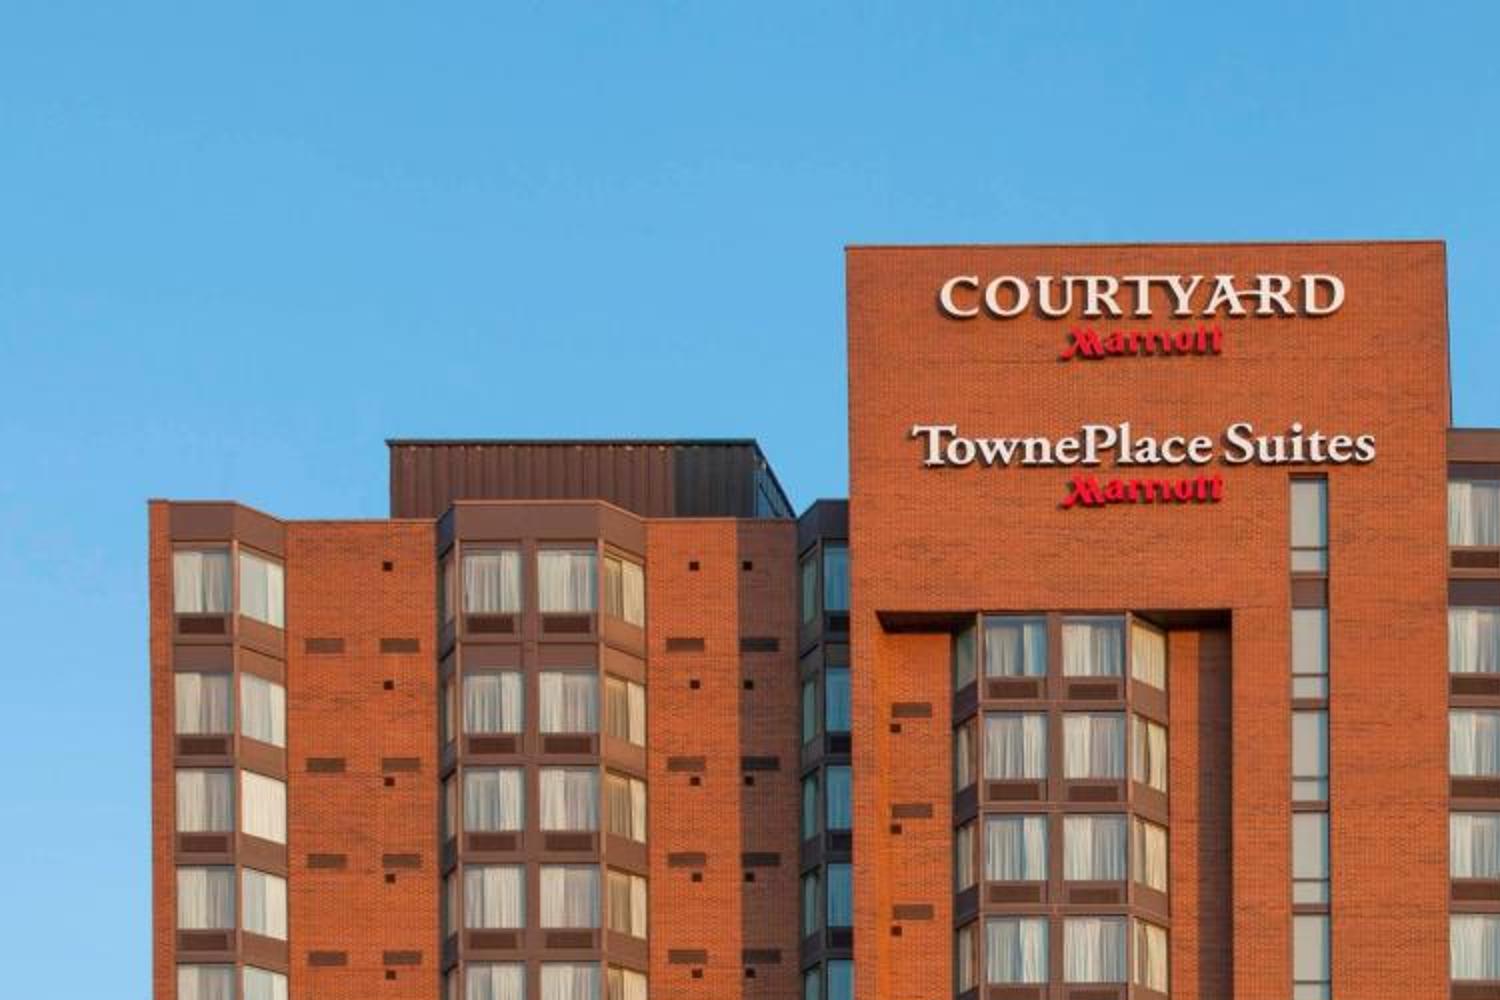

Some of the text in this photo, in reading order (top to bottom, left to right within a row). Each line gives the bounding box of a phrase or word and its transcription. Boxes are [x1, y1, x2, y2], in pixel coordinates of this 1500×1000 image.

[939, 274, 1346, 318] COURTYARD
[1061, 324, 1223, 360] Marriott
[912, 421, 1377, 467] TownePlace Suites
[1061, 473, 1223, 508] Marriott
